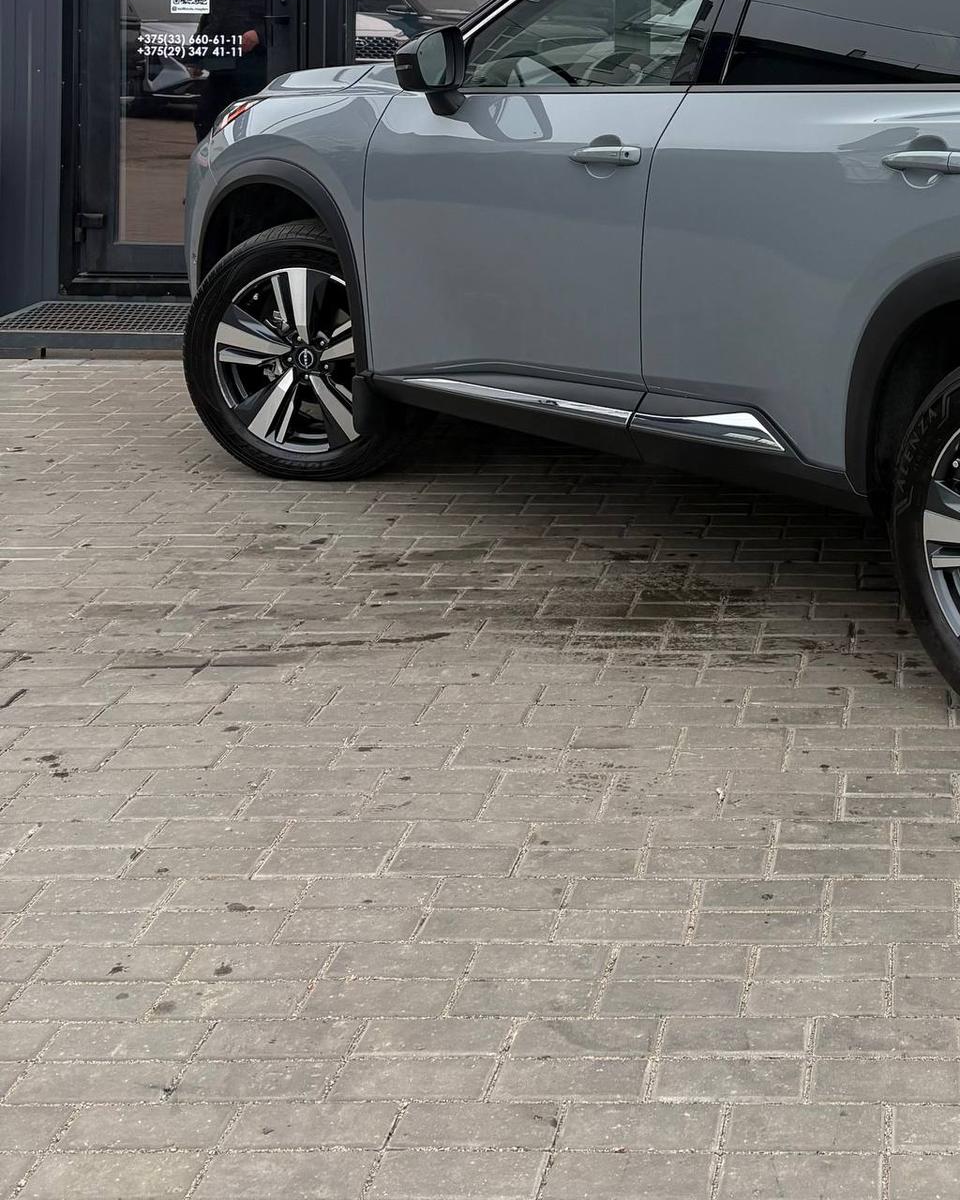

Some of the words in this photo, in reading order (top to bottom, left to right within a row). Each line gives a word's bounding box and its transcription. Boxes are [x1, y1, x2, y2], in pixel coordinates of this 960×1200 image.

[137, 33, 186, 46] +375(33)
[189, 34, 243, 45] 660-61-11
[137, 46, 186, 59] +375(29)
[188, 47, 208, 58] 347
[212, 47, 243, 58] 41-11
